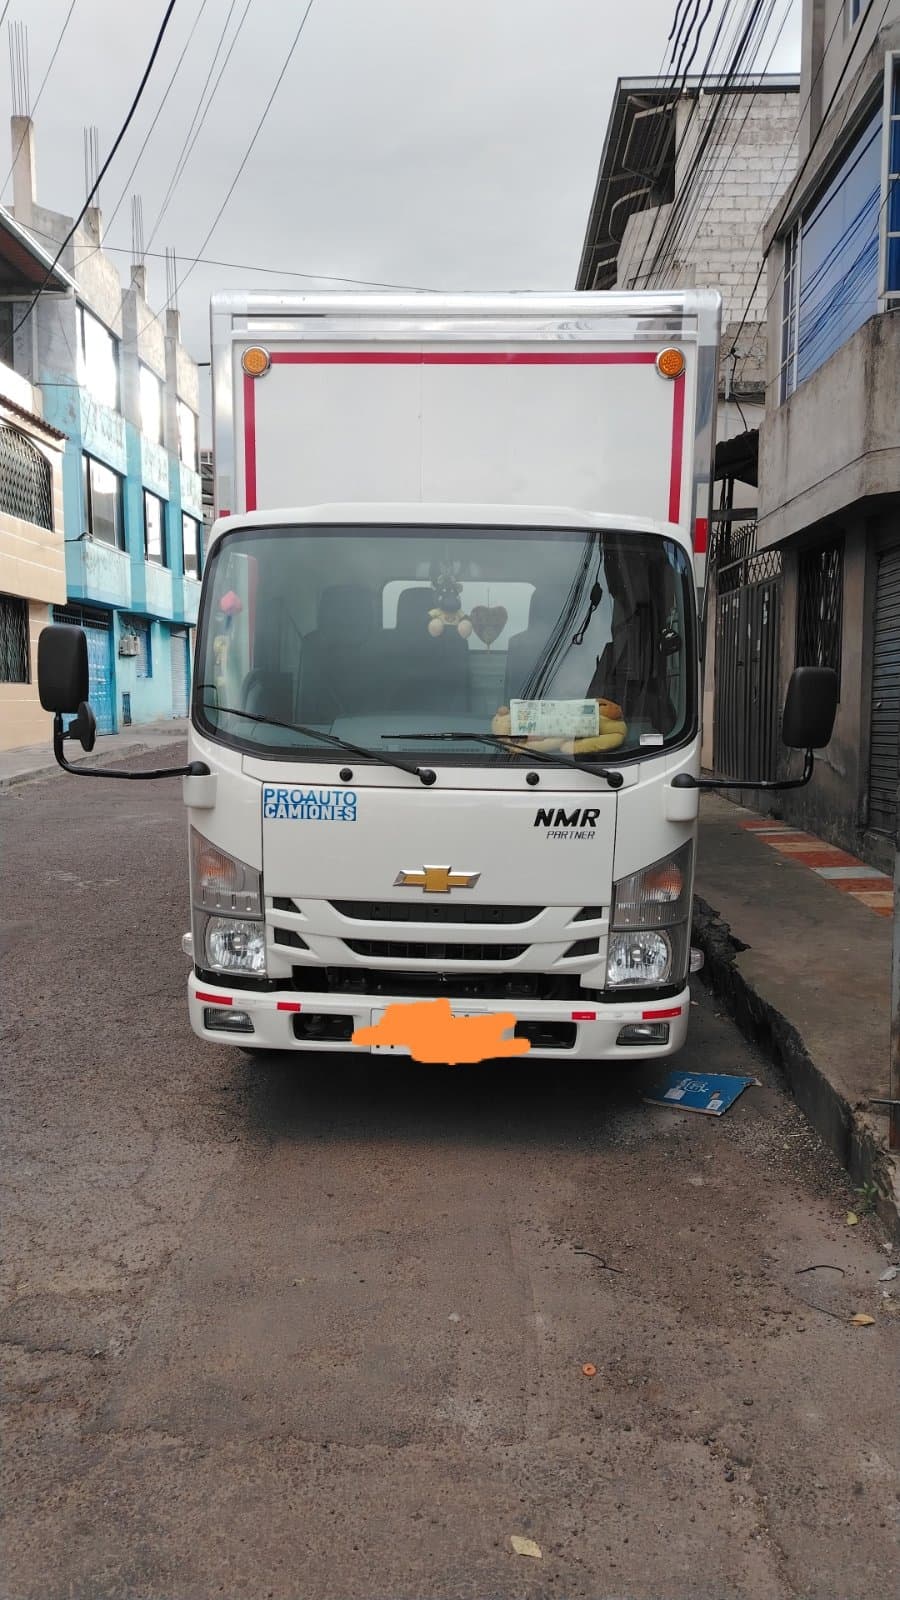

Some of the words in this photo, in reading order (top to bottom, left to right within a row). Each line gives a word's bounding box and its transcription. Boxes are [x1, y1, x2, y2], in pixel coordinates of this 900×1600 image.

[264, 788, 357, 806] PROAUTO
[264, 804, 356, 821] CAMIONES
[534, 808, 601, 827] NMR
[546, 830, 596, 840] PARTNER
